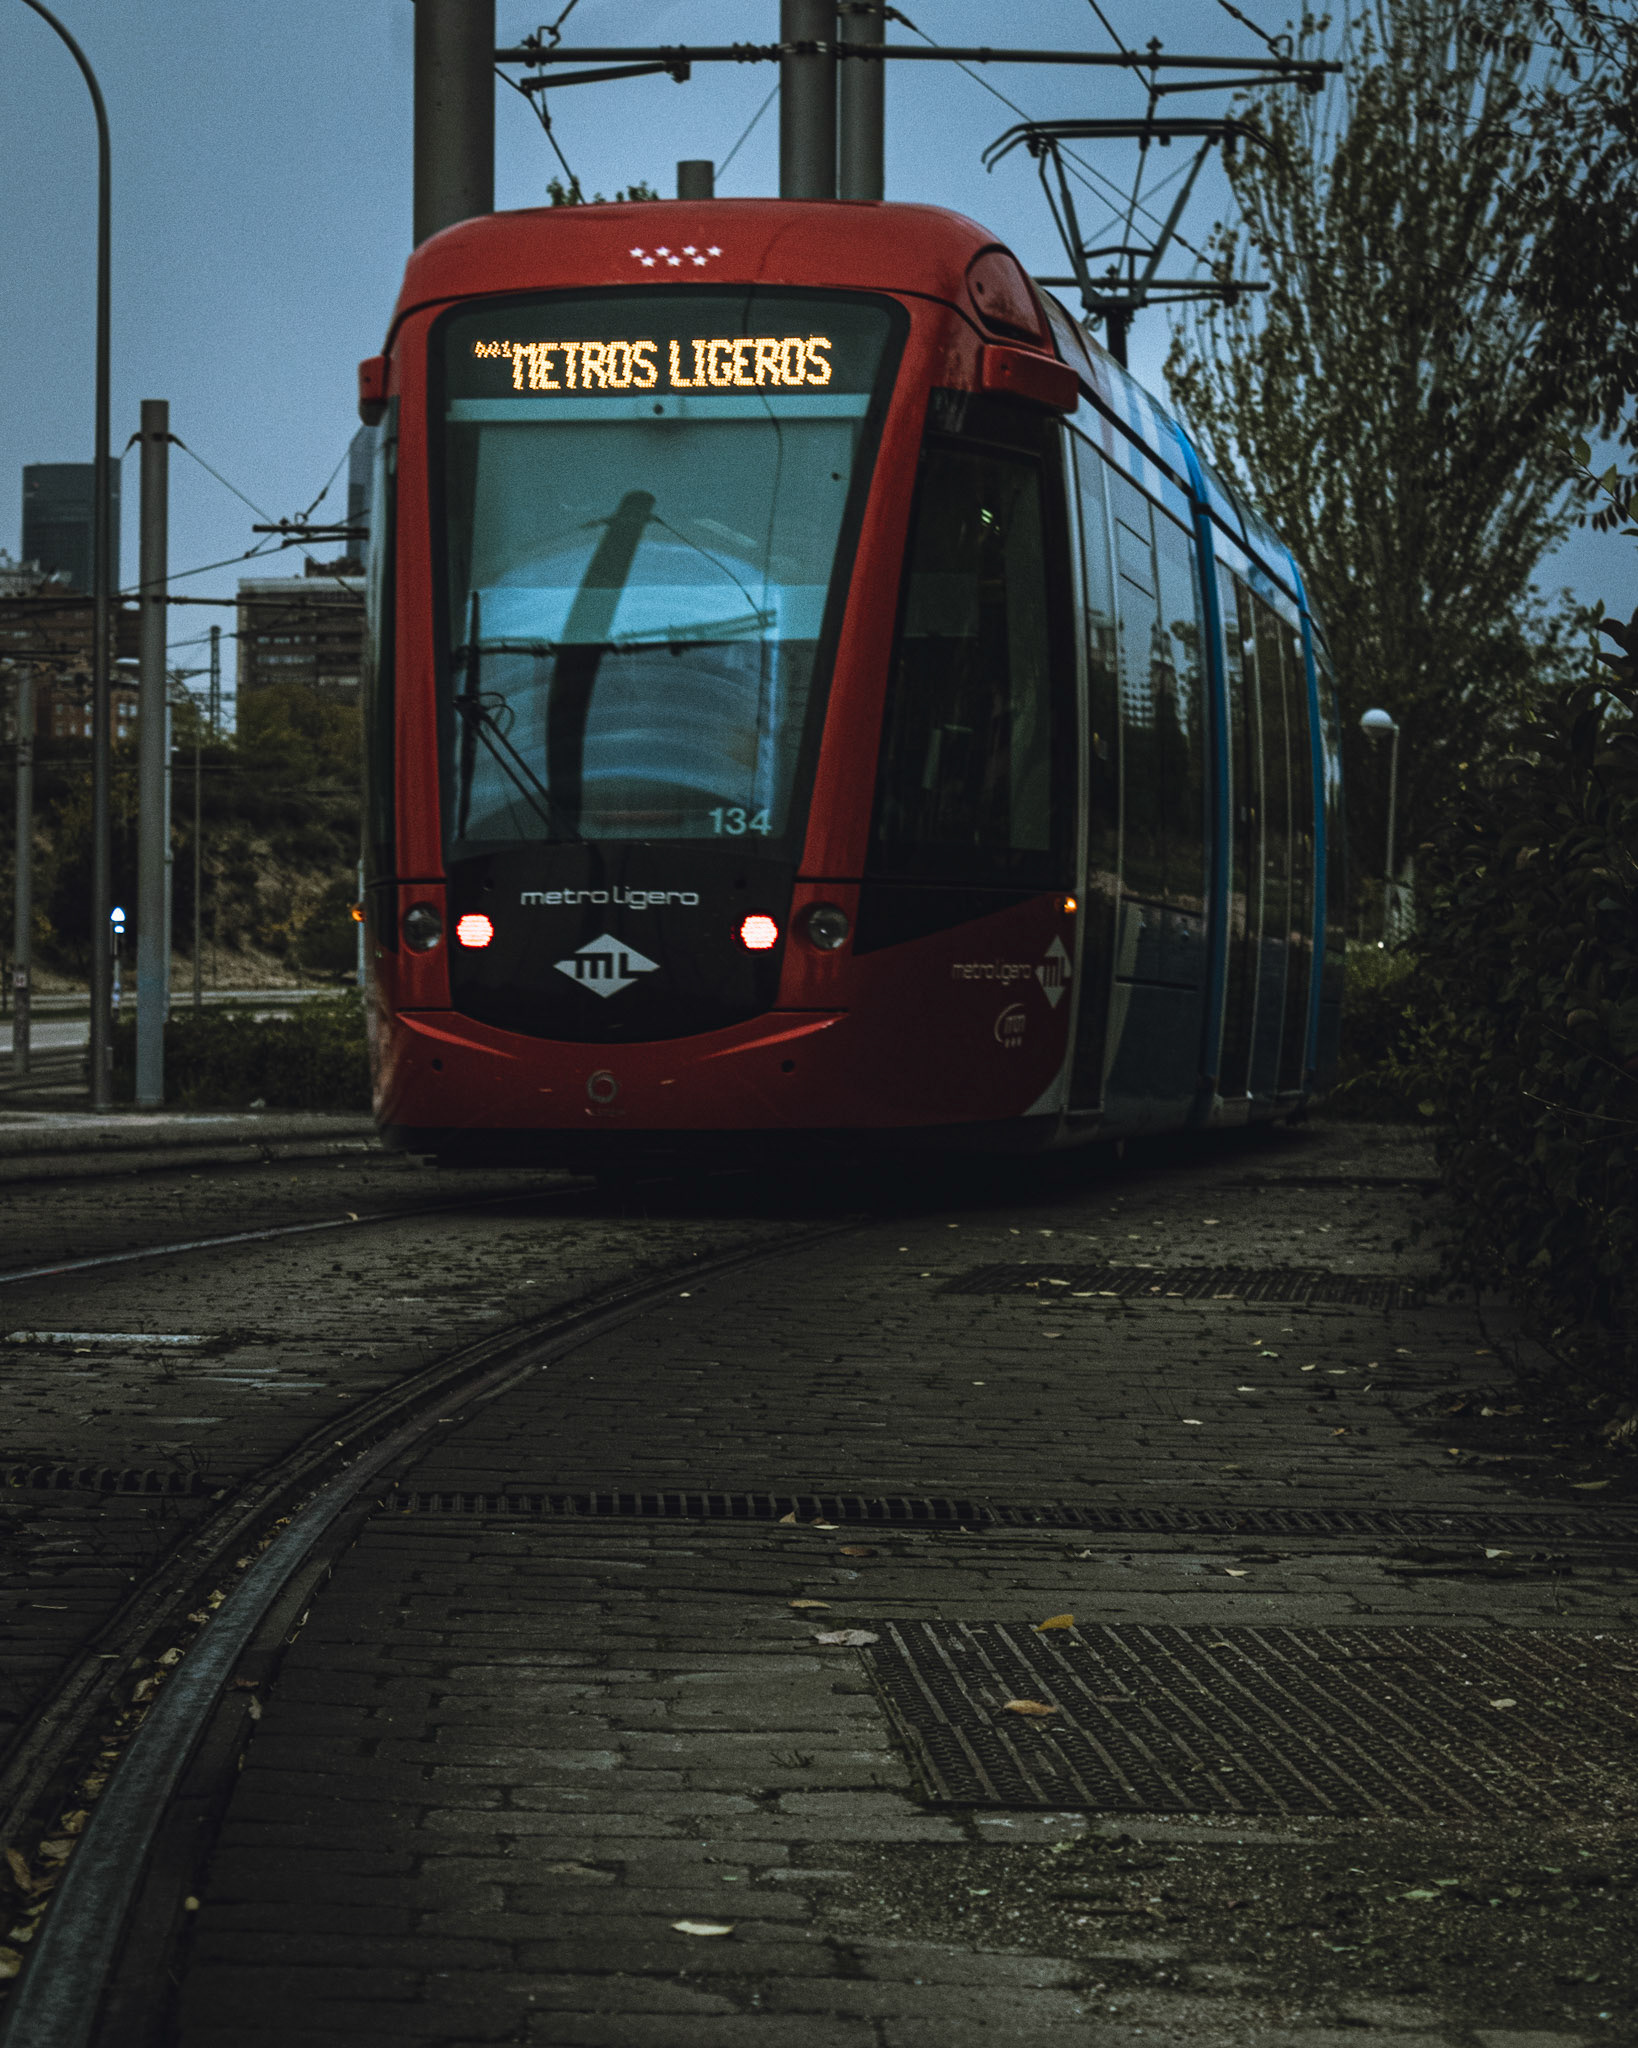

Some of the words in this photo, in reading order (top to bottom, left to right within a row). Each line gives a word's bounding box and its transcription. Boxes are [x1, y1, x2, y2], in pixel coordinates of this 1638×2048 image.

[512, 341, 658, 389] METROS
[669, 336, 833, 386] LIGEROS
[709, 807, 772, 836] 134
